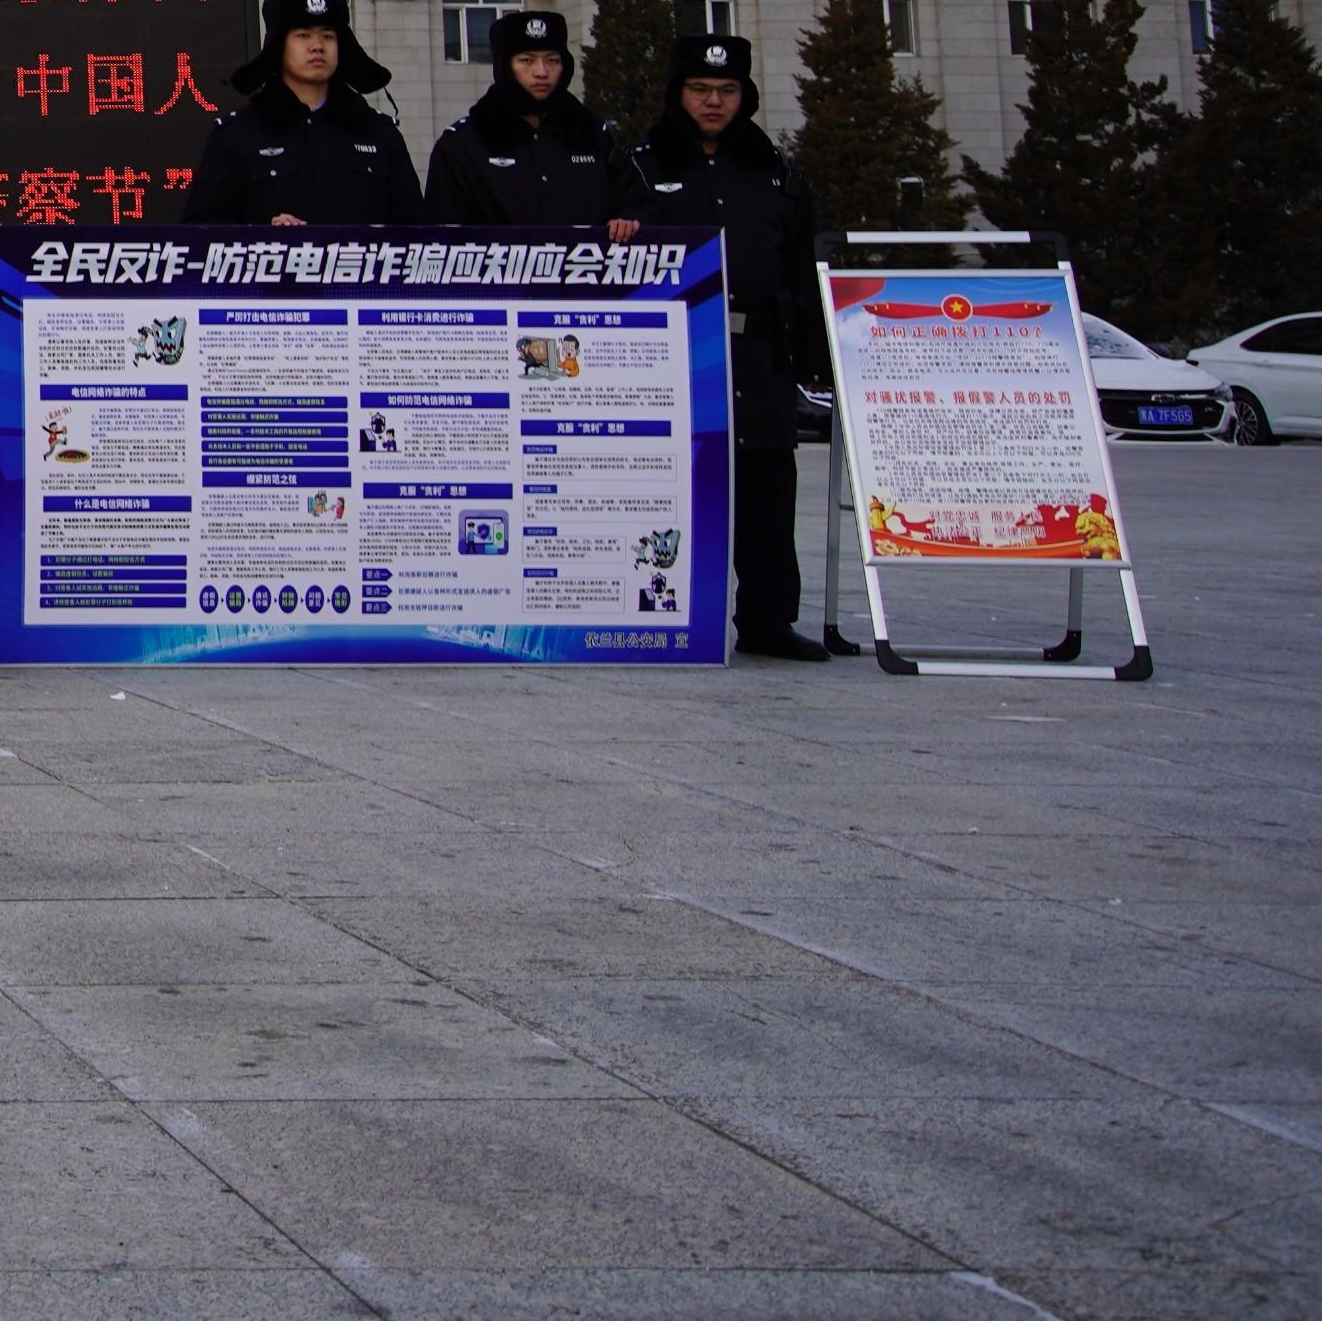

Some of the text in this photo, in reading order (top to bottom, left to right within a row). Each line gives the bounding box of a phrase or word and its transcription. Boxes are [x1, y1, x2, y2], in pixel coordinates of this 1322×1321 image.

[25, 241, 687, 285] 全民反诈-防范电信诈骗应知应会知识
[864, 389, 1072, 406] 对骚扰报警、报假警人员的处罚
[585, 632, 689, 648] 依兰县公安局 宣
